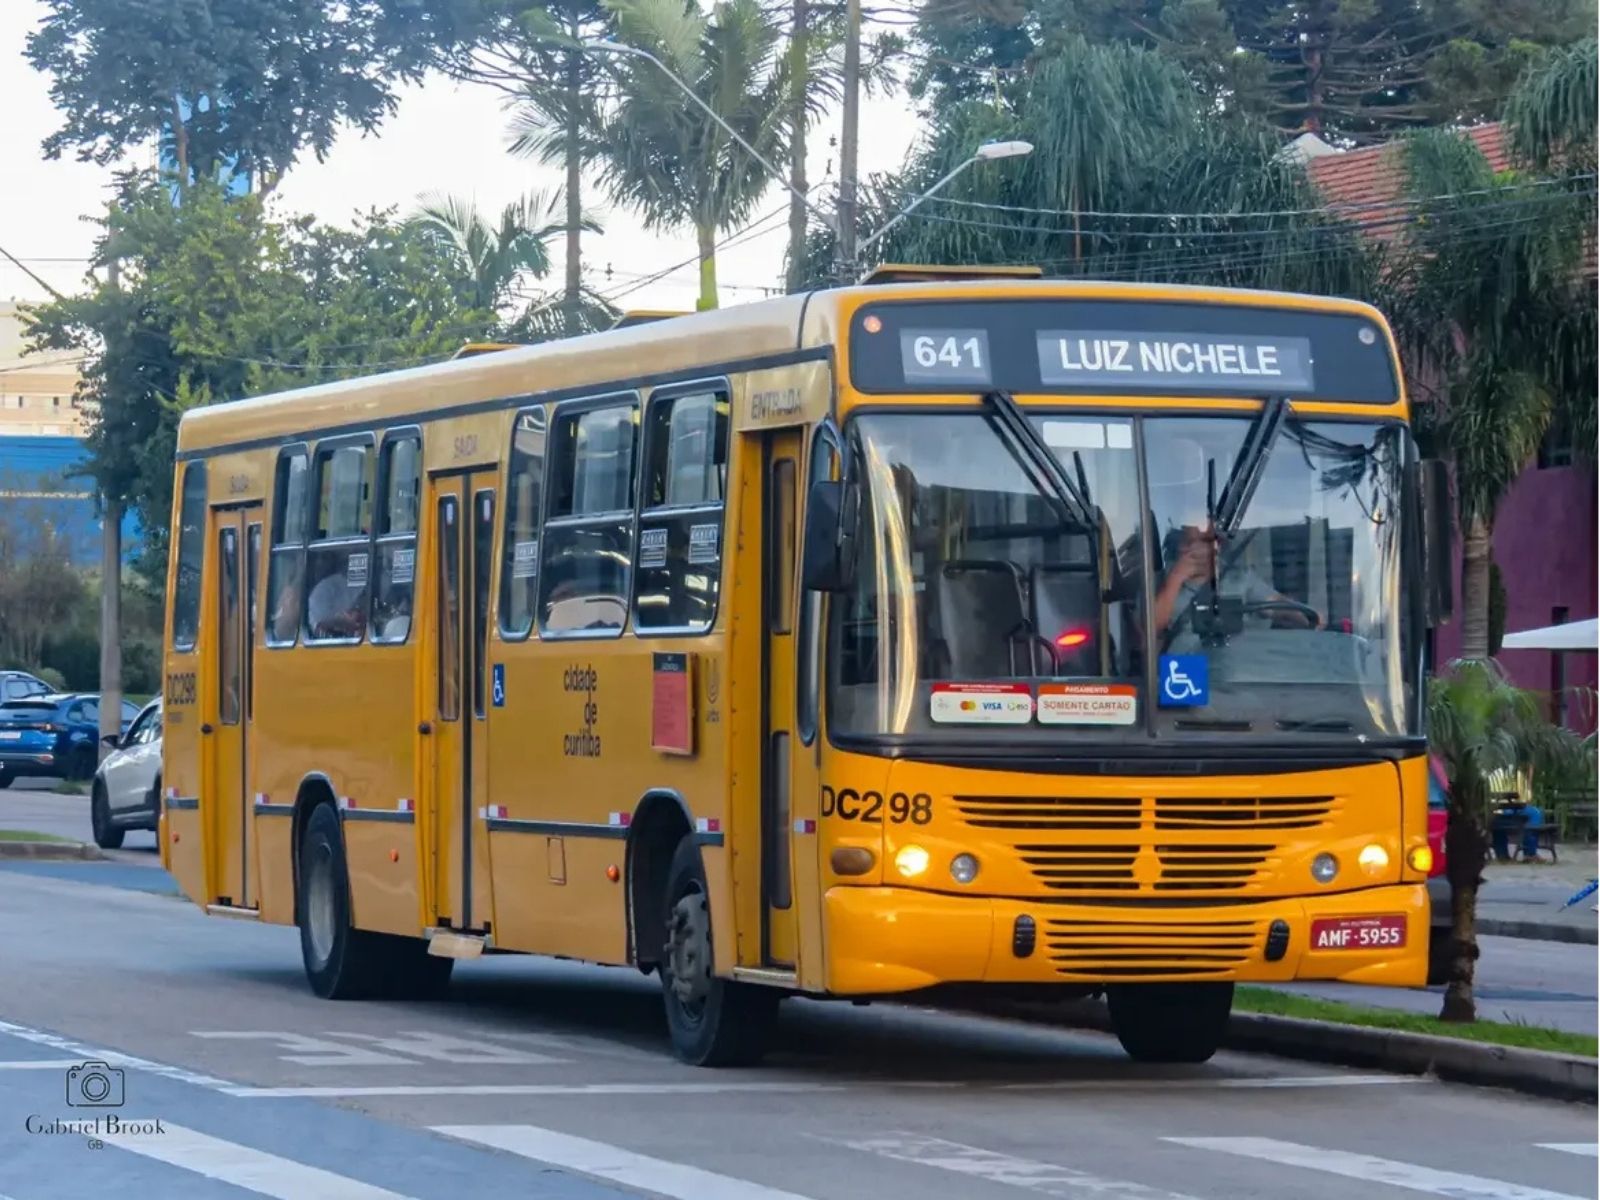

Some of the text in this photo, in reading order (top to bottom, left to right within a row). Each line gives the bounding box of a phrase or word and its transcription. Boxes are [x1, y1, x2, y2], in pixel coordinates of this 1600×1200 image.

[913, 336, 982, 369] 641
[1059, 338, 1282, 376] LUIZ NICHELE
[563, 663, 597, 692] cidade
[982, 702, 1003, 711] VISA
[1043, 700, 1088, 711] SOMENTE
[821, 785, 933, 825] DC298
